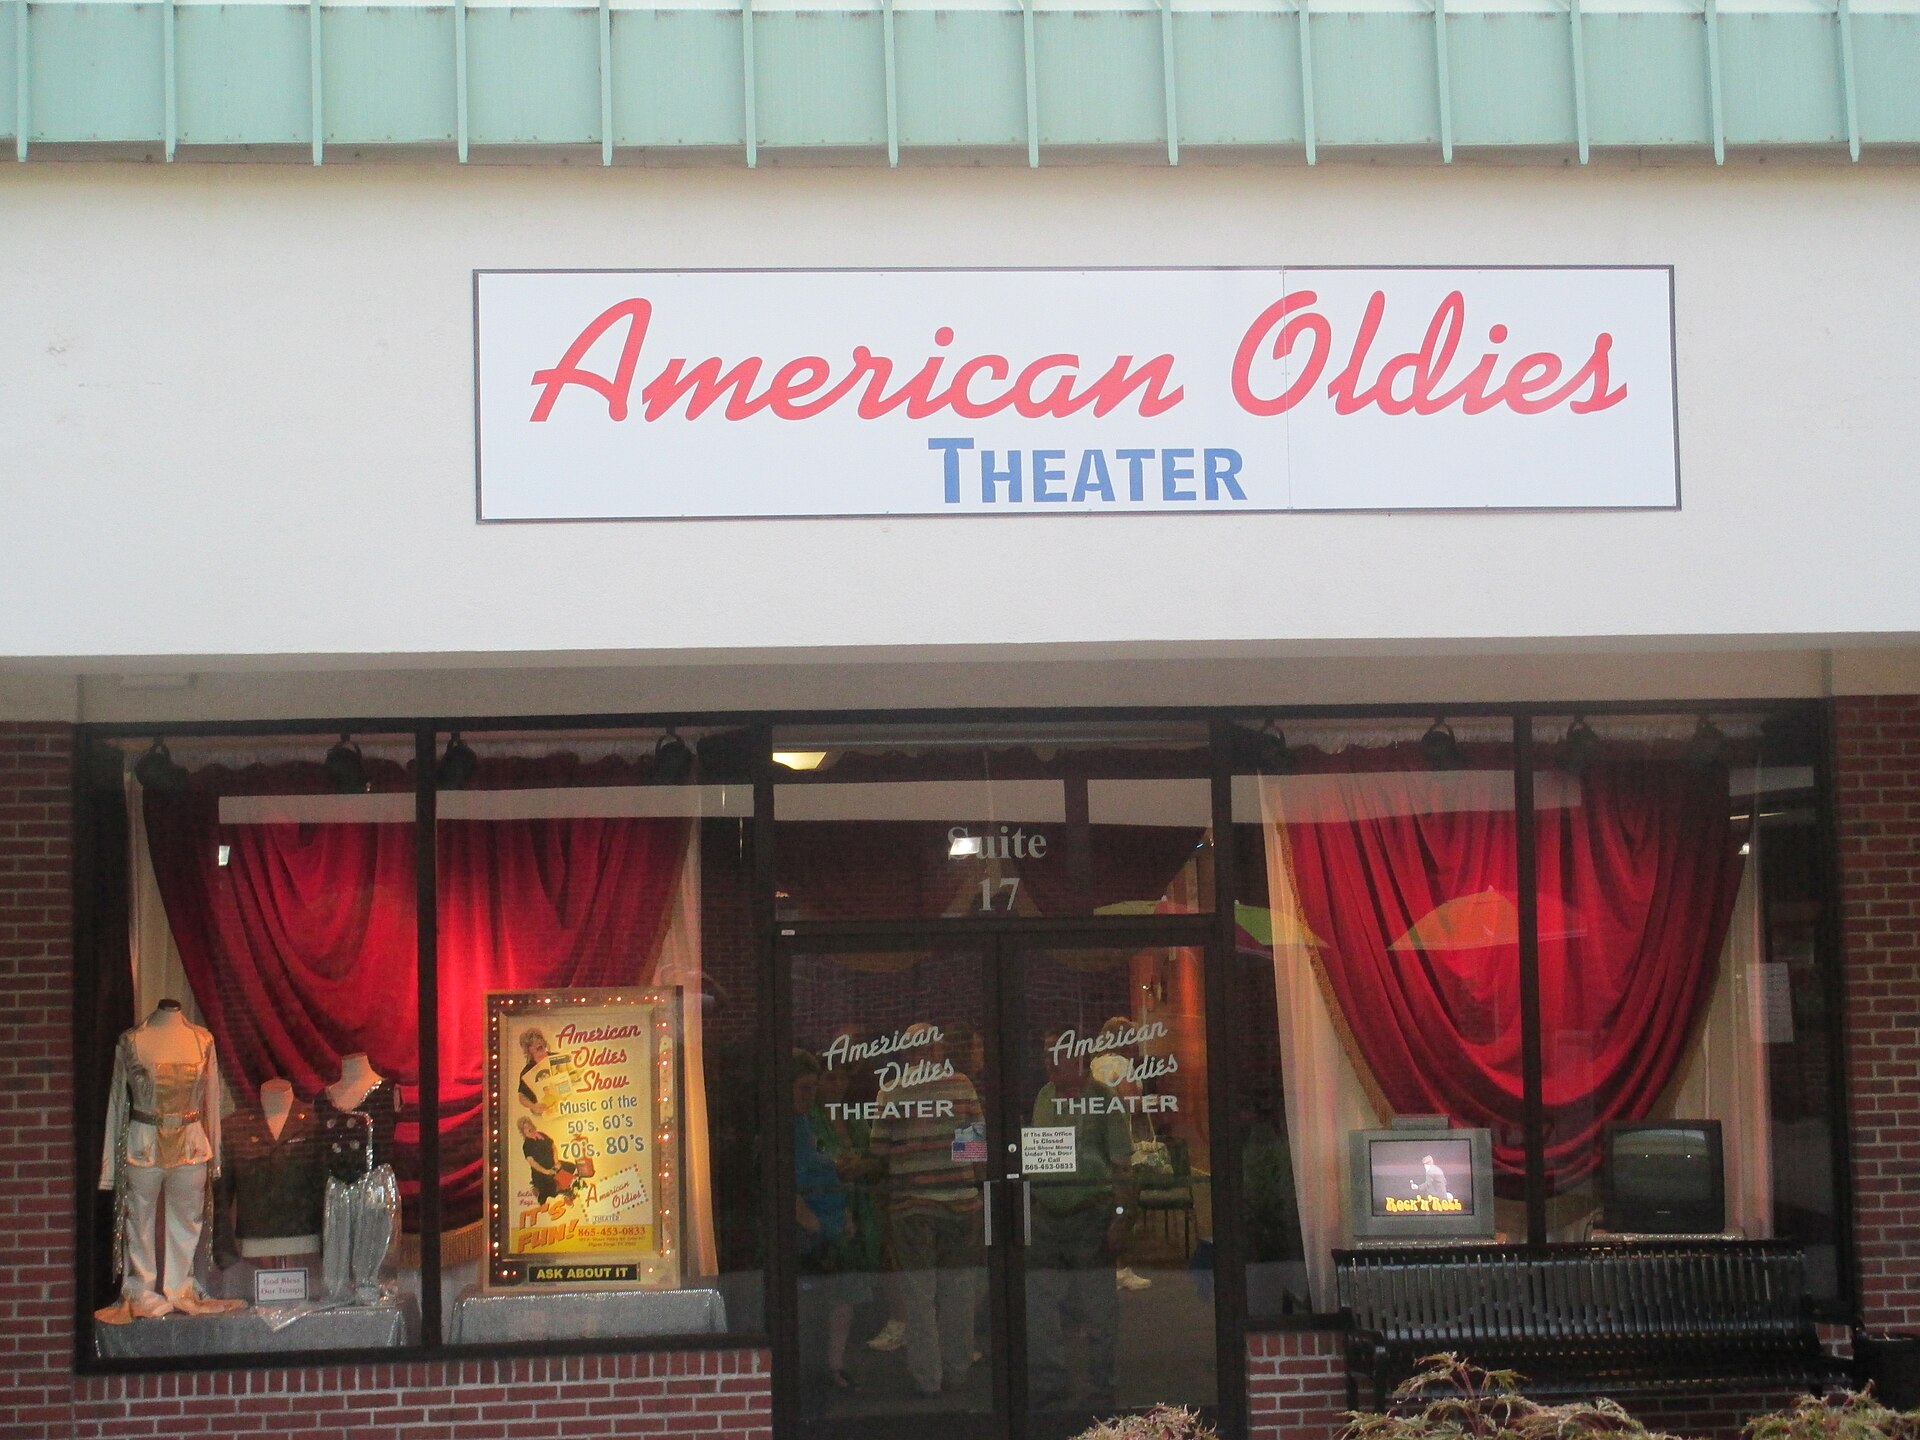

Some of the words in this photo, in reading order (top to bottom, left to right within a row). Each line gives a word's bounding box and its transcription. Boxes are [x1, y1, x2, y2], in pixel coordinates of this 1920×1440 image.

[529, 297, 1184, 422] American
[1231, 290, 1628, 416] Oldies
[928, 437, 1248, 503] THEATER
[978, 877, 1020, 911] 17
[556, 1024, 642, 1049] American
[822, 1025, 945, 1071] American
[1048, 1021, 1169, 1066] American
[571, 1046, 627, 1068] Oldies
[576, 1069, 630, 1093] Show
[874, 1058, 955, 1092] Oldies
[1099, 1054, 1178, 1088] Oldies
[559, 1100, 597, 1115] Music
[600, 1096, 614, 1110] of
[617, 1095, 638, 1109] the
[824, 1100, 955, 1121] THEATER
[1051, 1095, 1179, 1115] THEATER
[602, 1114, 634, 1130] 60's
[606, 1134, 645, 1155] 80's
[586, 1183, 629, 1207] American
[612, 1191, 643, 1208] Oldies
[518, 1199, 566, 1231] IT'S
[517, 1219, 580, 1253] FUN!
[577, 1226, 646, 1237] 865-453-0833
[536, 1268, 563, 1279] ASK
[566, 1268, 612, 1279] ABOUT
[615, 1267, 629, 1278] IT
